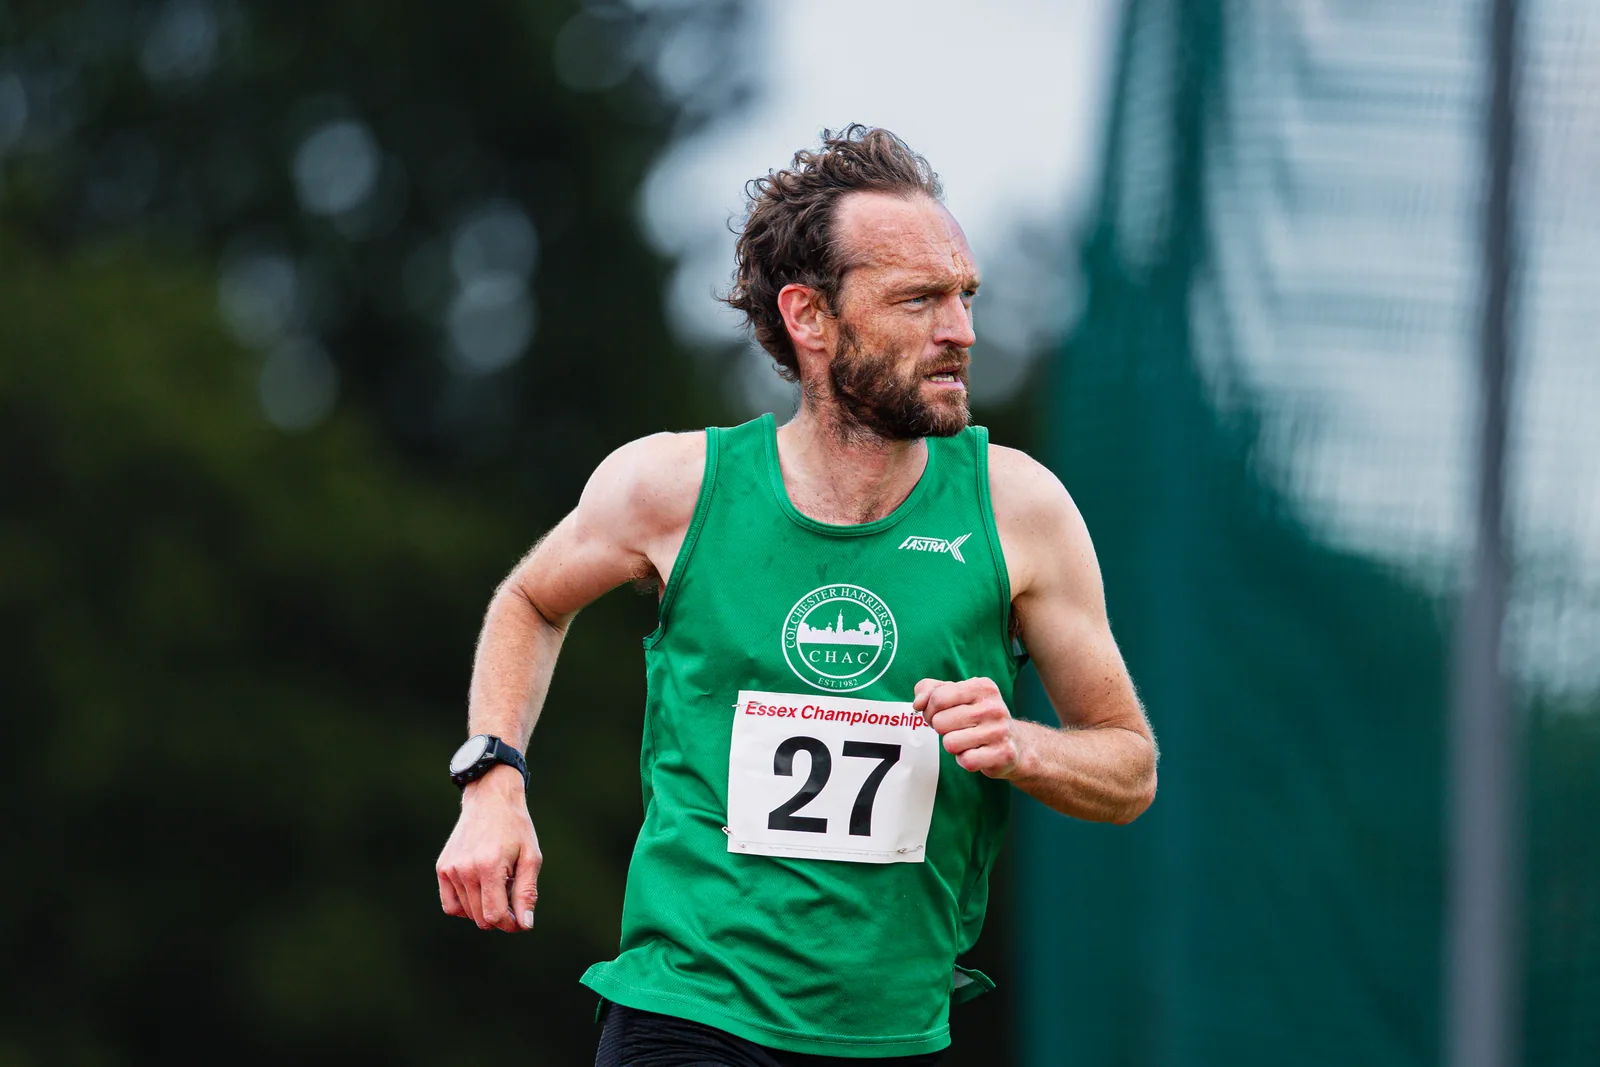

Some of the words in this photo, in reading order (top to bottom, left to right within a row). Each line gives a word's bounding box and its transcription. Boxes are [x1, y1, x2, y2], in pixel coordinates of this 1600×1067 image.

[898, 532, 972, 564] FASTRAX
[785, 588, 837, 649] COLCHESTER
[840, 588, 891, 627] HARRIERS
[809, 650, 869, 665] CHAC
[745, 701, 798, 718] Essex
[767, 735, 902, 837] 27
